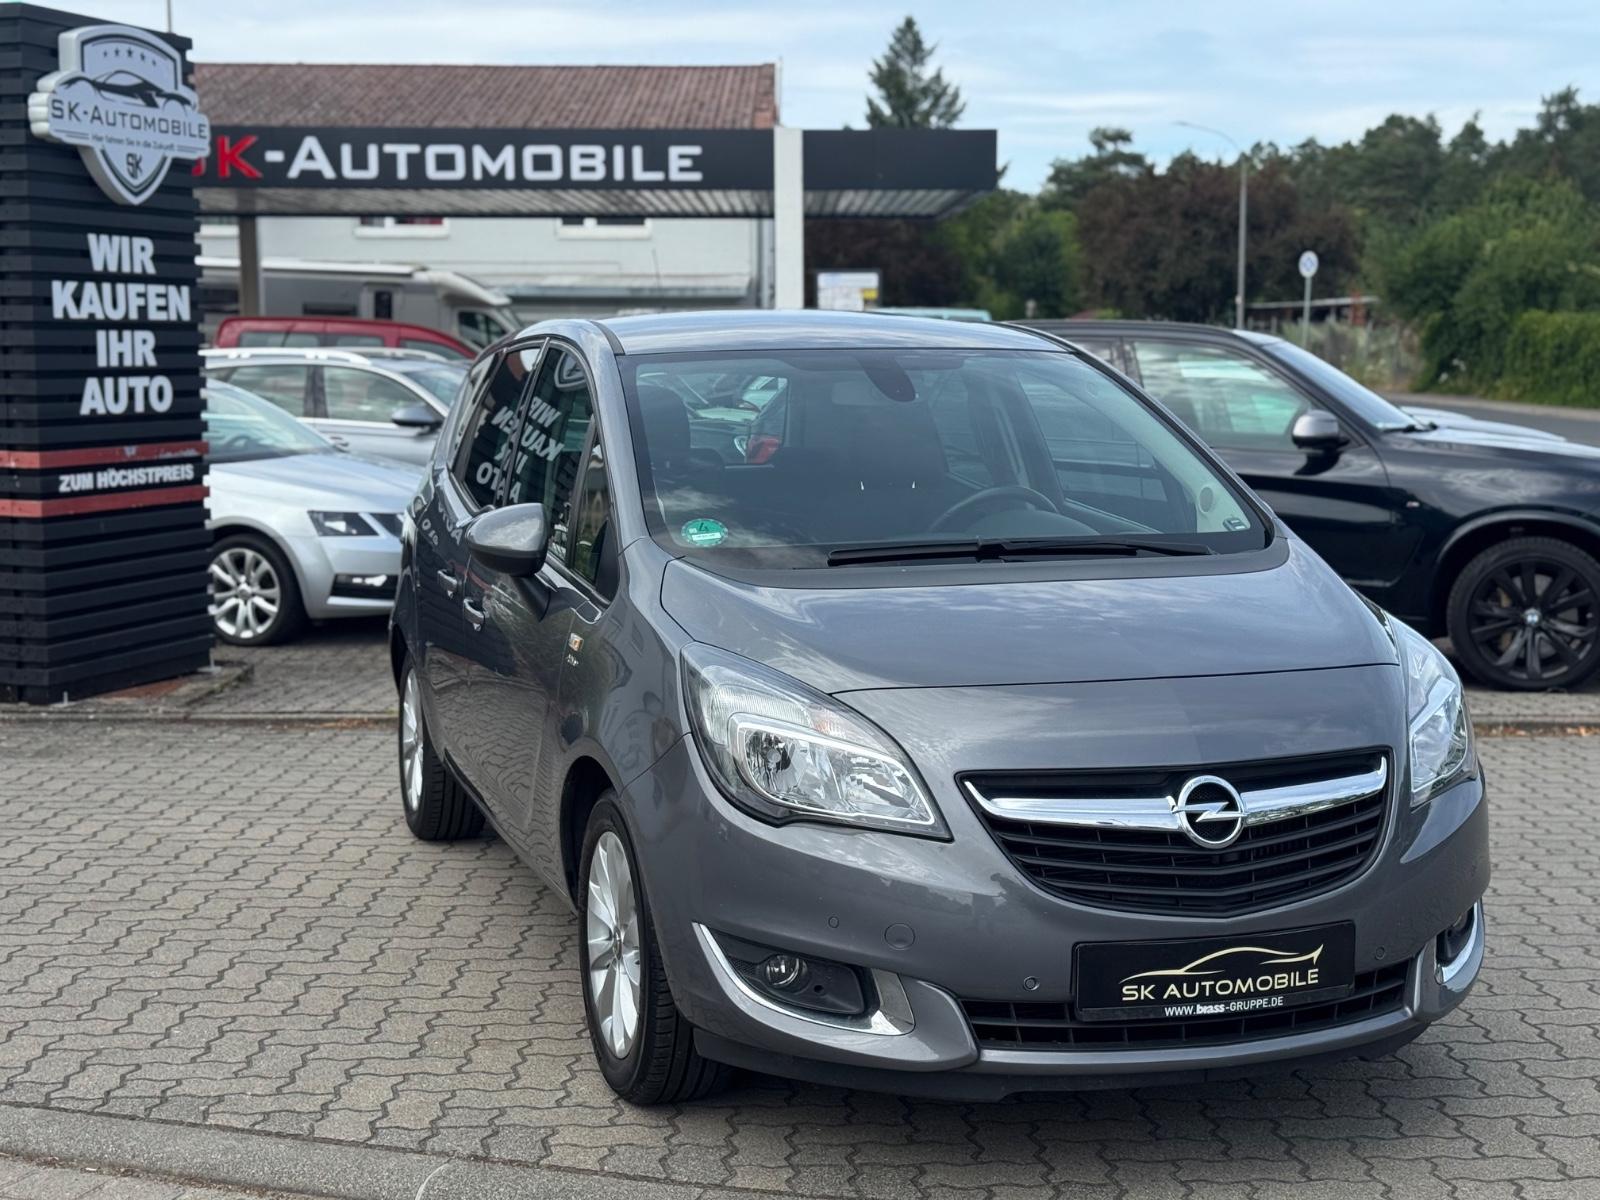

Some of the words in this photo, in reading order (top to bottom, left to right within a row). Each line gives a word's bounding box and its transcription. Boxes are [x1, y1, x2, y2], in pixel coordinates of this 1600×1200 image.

[192, 136, 703, 181] K-AUTOMOBILE
[87, 233, 156, 275] WIR
[51, 280, 191, 321] KAUFEN
[96, 330, 157, 368] IHR
[79, 375, 173, 415] AUTO
[58, 472, 93, 492] ZUM
[96, 463, 194, 488] HÖCHSTPREIS
[1122, 985, 1155, 1001] SK
[1163, 968, 1319, 1000] AUTOMOBILE
